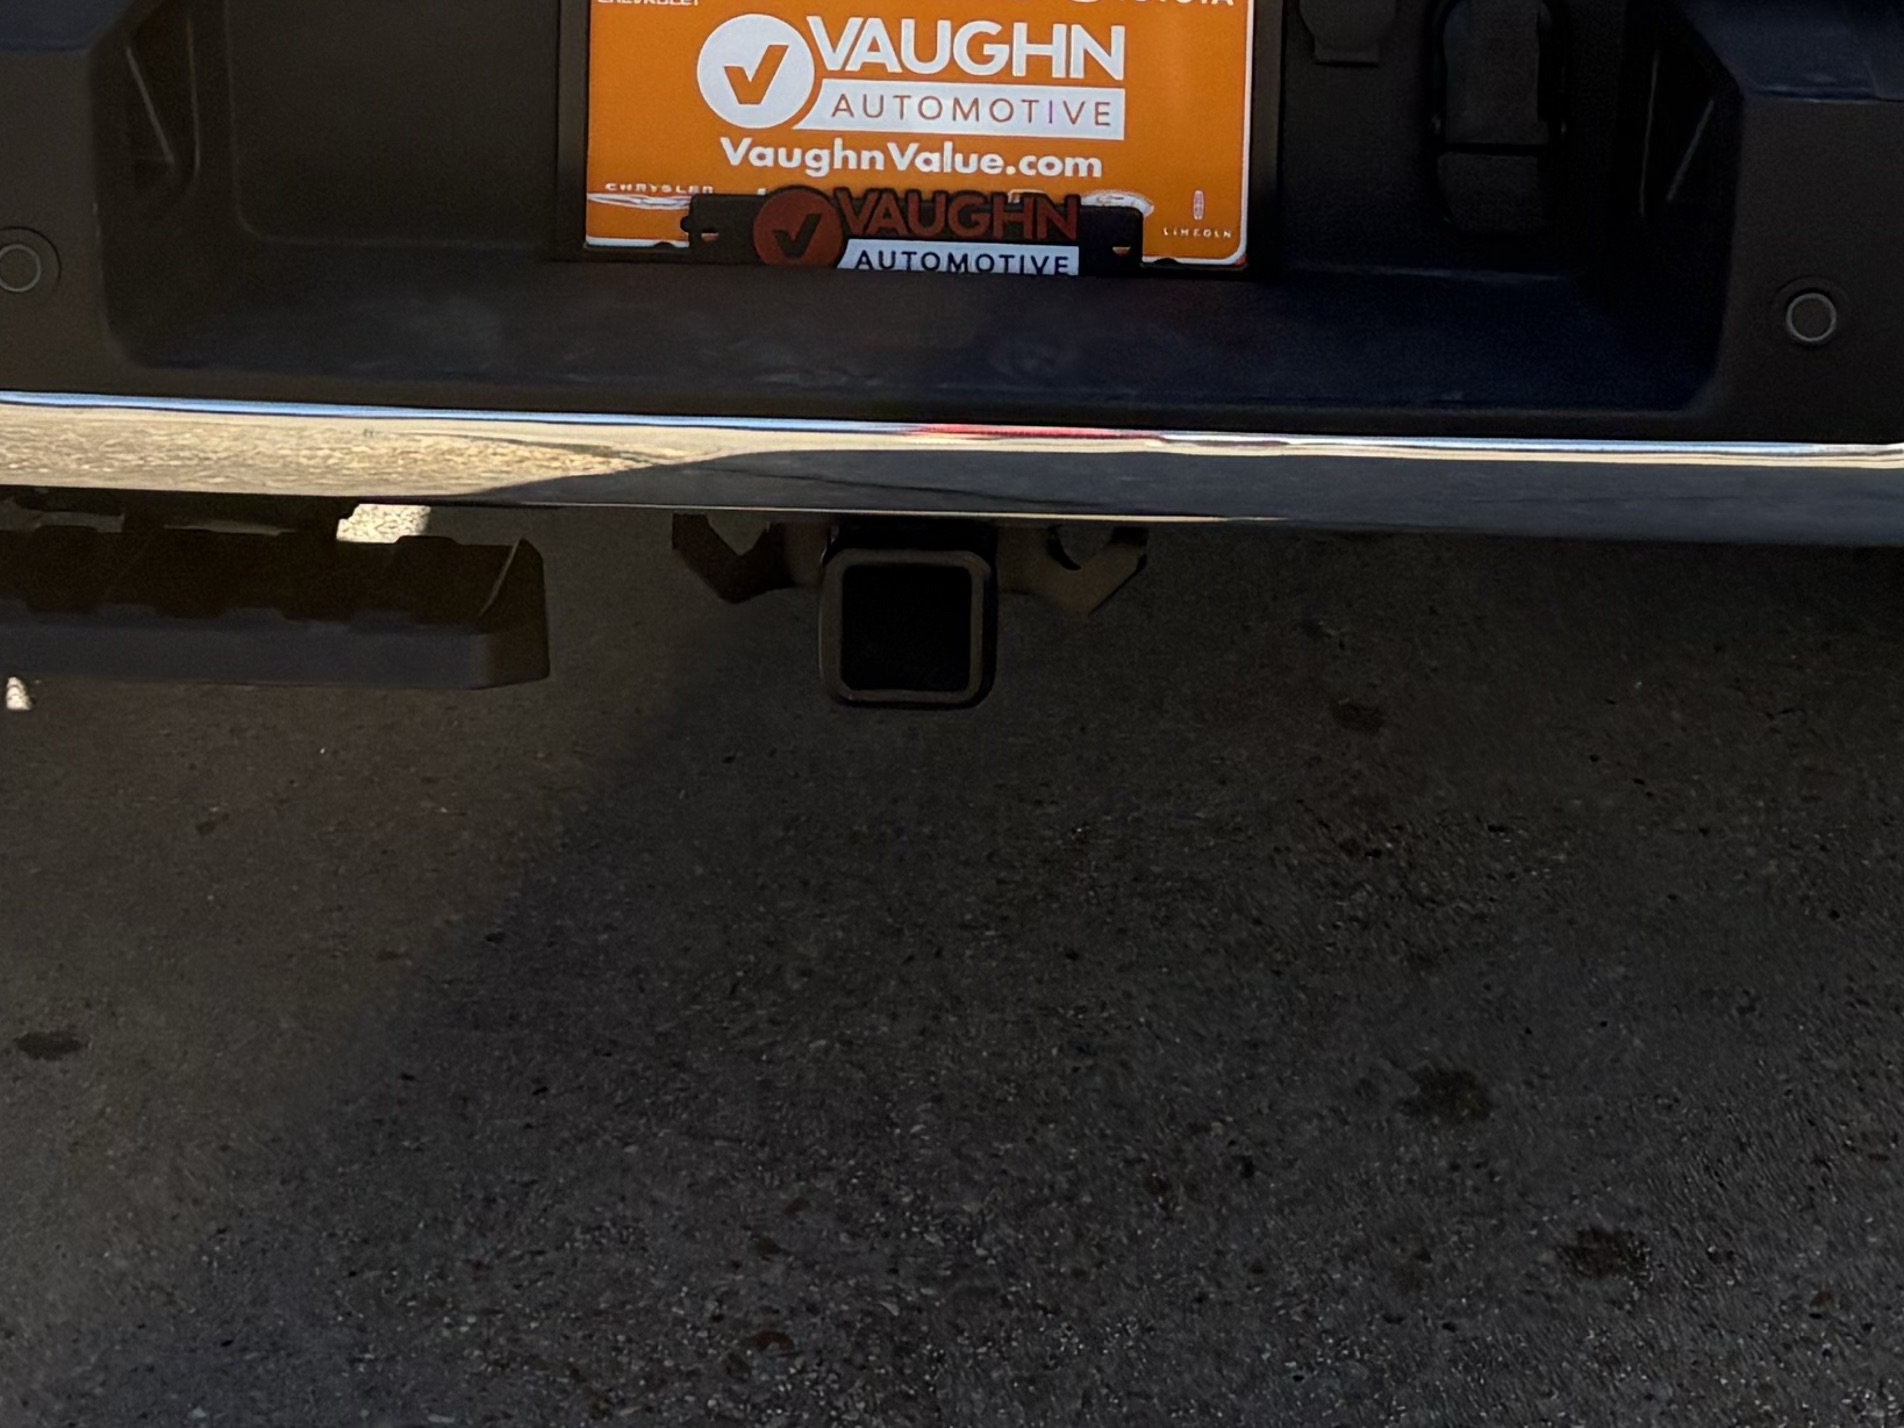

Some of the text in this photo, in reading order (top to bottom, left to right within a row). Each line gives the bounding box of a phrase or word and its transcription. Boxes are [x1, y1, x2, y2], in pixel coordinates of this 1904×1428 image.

[807, 15, 1126, 81] VAUGHN
[831, 91, 1112, 128] AUTOMOTIVE
[720, 137, 1103, 179] VaughnValue.com
[604, 182, 714, 195] CHRYSLER
[835, 189, 1080, 241] VAUGHN
[1162, 226, 1233, 239] LINCOLN
[854, 248, 1070, 275] AUTOMOTIVE
